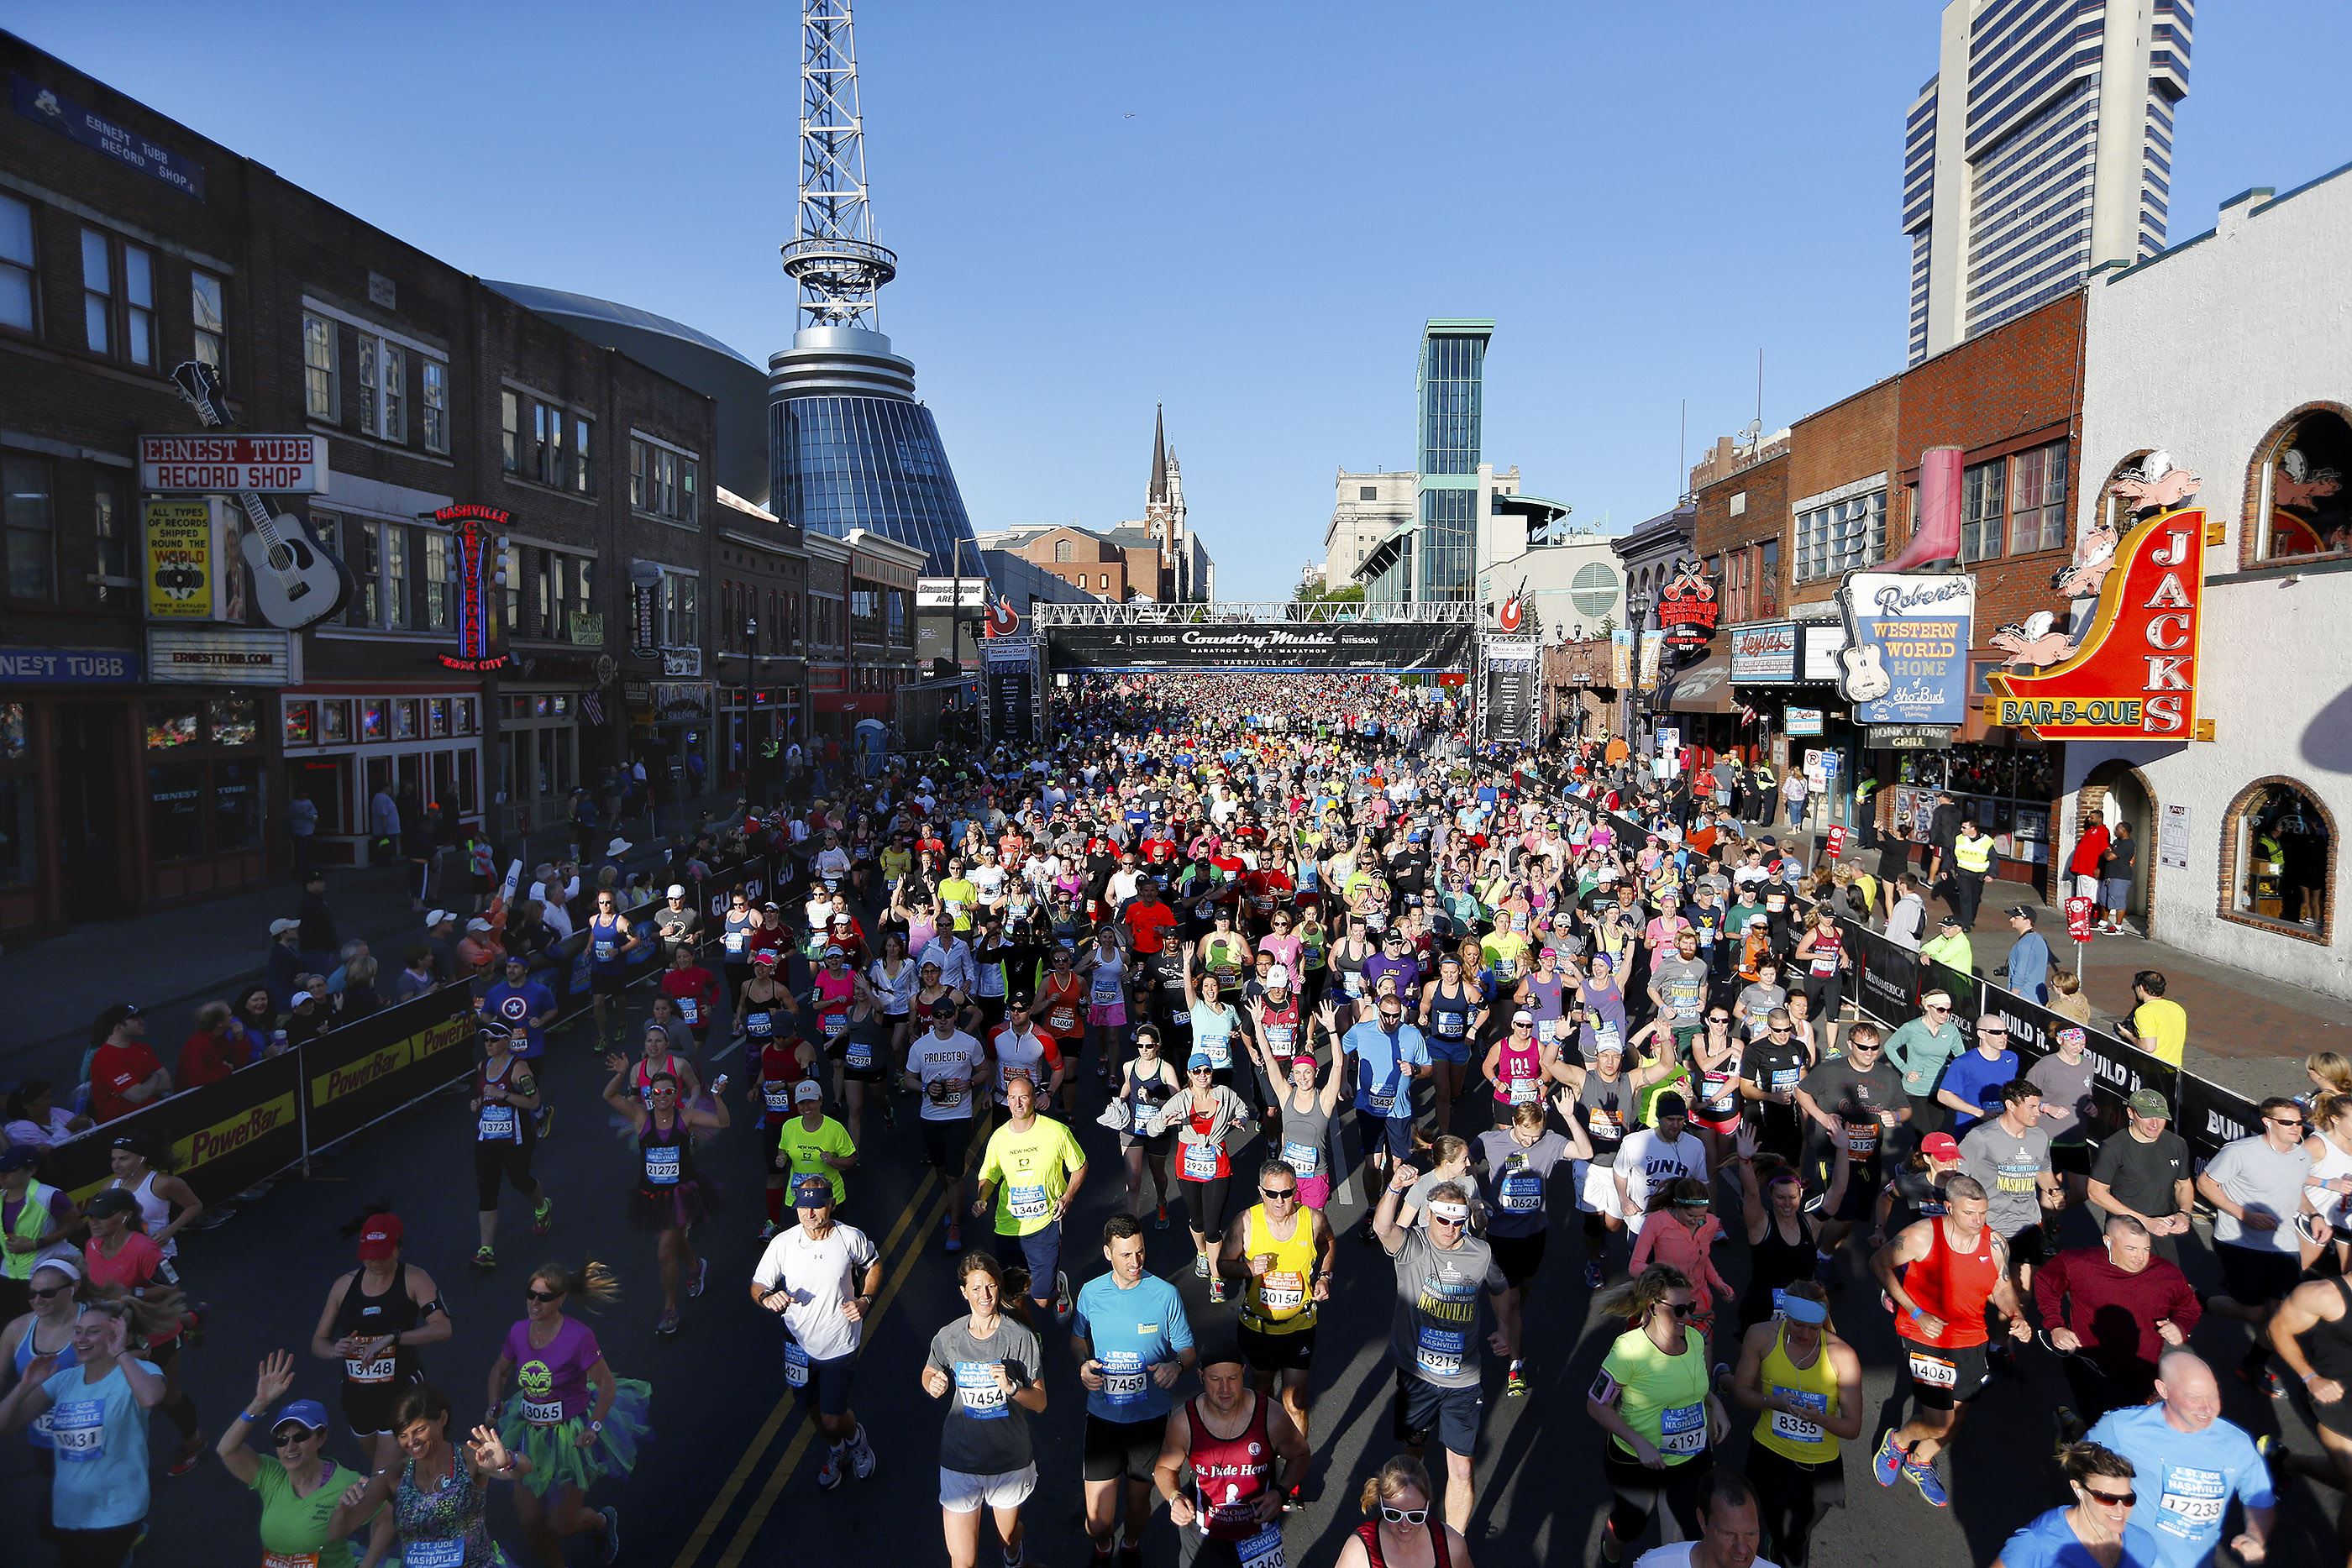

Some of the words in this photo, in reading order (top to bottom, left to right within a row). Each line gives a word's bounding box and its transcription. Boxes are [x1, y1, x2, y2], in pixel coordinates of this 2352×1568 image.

[86, 113, 131, 145] ERNEST
[141, 142, 169, 164] TUBB
[101, 137, 145, 167] RECORD
[159, 166, 186, 186] SHOP
[145, 438, 237, 462] ERNEST
[250, 438, 312, 462] TUBB
[159, 467, 239, 487] RECORD
[249, 467, 301, 487] SHOP
[153, 508, 168, 517] ALL
[175, 508, 203, 517] TYPES
[436, 505, 509, 525] NASHVILLE
[148, 518, 160, 527] OF
[165, 518, 207, 527] RECORDS
[160, 529, 198, 538] SHIPPED
[152, 539, 183, 548] ROUND
[189, 539, 206, 548] THE
[155, 550, 204, 564] WORLD
[464, 522, 480, 658] CROSSROADS
[917, 584, 981, 594] BRIDGETONE
[1874, 577, 1971, 616] Robert's
[1658, 601, 1719, 616] SECOND
[1660, 613, 1714, 629] FIDDLE
[1872, 621, 1959, 638] WESTERN
[2143, 530, 2194, 733] JACKS
[1182, 630, 1268, 649] Country
[1268, 630, 1336, 645] Music
[173, 653, 272, 664] ERNESTTUBB.COM
[1885, 642, 1956, 659] WORLD
[67, 657, 124, 678] TUBB
[1618, 648, 1627, 683] WELCOME
[1893, 660, 1946, 676] HOME
[1912, 677, 1921, 689] of
[1893, 686, 1945, 704] Sho-Bud
[668, 711, 699, 720] SALOON
[1872, 712, 1890, 721] GRILL
[2001, 700, 2142, 725] BAR-B-QUE
[1869, 726, 1912, 739] HONKY
[1916, 726, 1948, 739] TONK
[1892, 738, 1925, 747] GRILL
[153, 789, 202, 802] ERNEST
[745, 878, 764, 900] GU
[711, 889, 731, 916] GU
[1864, 966, 1907, 1000] TRANSAMERICA
[1052, 1018, 1073, 1027] 13004
[328, 1051, 399, 1100] PowerBar
[482, 1122, 511, 1131] 13723
[190, 1104, 281, 1167] PowerBar
[648, 1165, 678, 1175] 21272
[1186, 1161, 1215, 1172] 29265
[1505, 1160, 1522, 1170] HALF
[1014, 1204, 1045, 1214] 13469
[1507, 1198, 1539, 1208] 10624
[1261, 1291, 1299, 1304] 20154
[1417, 1291, 1474, 1322] NASHVILLE
[1421, 1337, 1462, 1349] NASHVILLE
[1420, 1350, 1462, 1370] 13215
[1913, 1362, 1952, 1382] 14061
[1104, 1377, 1144, 1392] 17459
[963, 1388, 1004, 1405] 17454
[521, 1402, 559, 1419] 13065
[1665, 1413, 1703, 1429] NASHVILLE
[1778, 1415, 1817, 1434] 8355
[1668, 1431, 1702, 1449] 6197
[1195, 1464, 1209, 1476] St.
[1210, 1464, 1238, 1478] Jude
[1240, 1463, 1268, 1476] Hero
[2184, 1468, 2199, 1478] ST.
[2201, 1471, 2221, 1480] JUDE
[2168, 1479, 2225, 1493] NASHVILLE
[2169, 1498, 2220, 1517] 17233
[421, 1541, 432, 1550] ST.
[433, 1539, 454, 1549] JUDE
[1241, 1529, 1282, 1555] NASHVILLE
[407, 1553, 460, 1565] NASHVILLE
